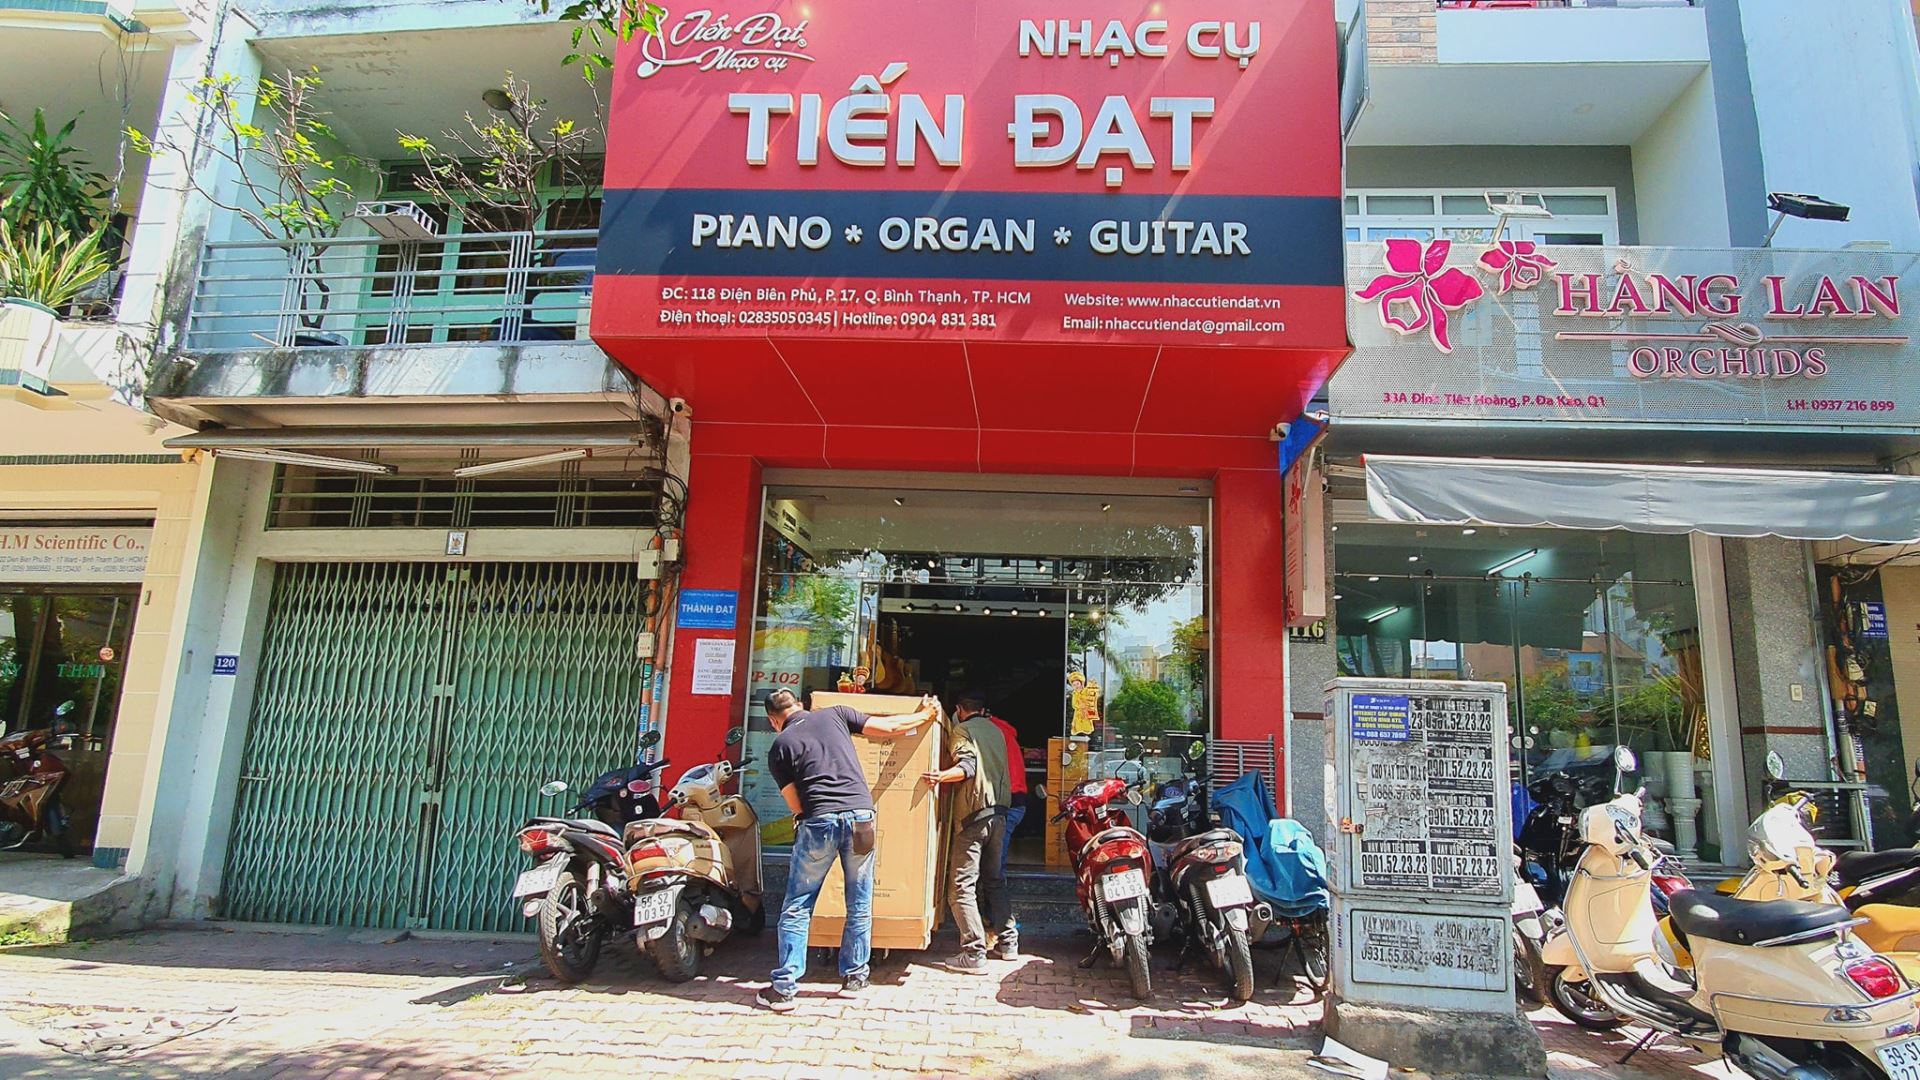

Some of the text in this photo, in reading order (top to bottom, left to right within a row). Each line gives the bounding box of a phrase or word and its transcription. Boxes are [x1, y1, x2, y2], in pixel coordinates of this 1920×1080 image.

[1019, 18, 1261, 70] NHẠC CỤ
[700, 46, 788, 74] Nhạc cụ
[728, 62, 1215, 187] TIẾN ĐẠT
[692, 213, 1252, 257] PIANO ORGAN GUITAR
[661, 287, 688, 300] ĐC:
[691, 288, 716, 300] 118
[719, 288, 752, 303] Điện
[756, 288, 786, 301] Biên
[790, 288, 822, 304] Phủ,
[825, 289, 836, 301] P.
[840, 289, 860, 304] 17,
[864, 290, 880, 304] Q.
[884, 290, 913, 302] Bình
[972, 291, 993, 303] TP.
[997, 291, 1031, 304] HCM
[1064, 292, 1281, 309] Website: www.nhaccutiendat.vn
[1763, 275, 1901, 320] LAN
[659, 309, 692, 325] Điện
[695, 310, 736, 326] thoại:
[842, 312, 898, 326] Hotline:
[900, 312, 937, 326] 0904
[941, 313, 967, 327] 831
[971, 313, 997, 327] 381
[1063, 316, 1285, 334] Email: nhaccutiendat@gmail.com
[1628, 346, 1829, 380] ORCHIDS
[1787, 399, 1895, 412] LH: 0937 216 899
[33, 534, 108, 550] Scientific
[682, 602, 735, 616] THÀNH ĐẠT
[216, 658, 236, 668] 120
[1362, 854, 1428, 874] 0901.52.23.23
[1431, 856, 1498, 877] 0901.52.23.23
[641, 893, 669, 909] 59-S2
